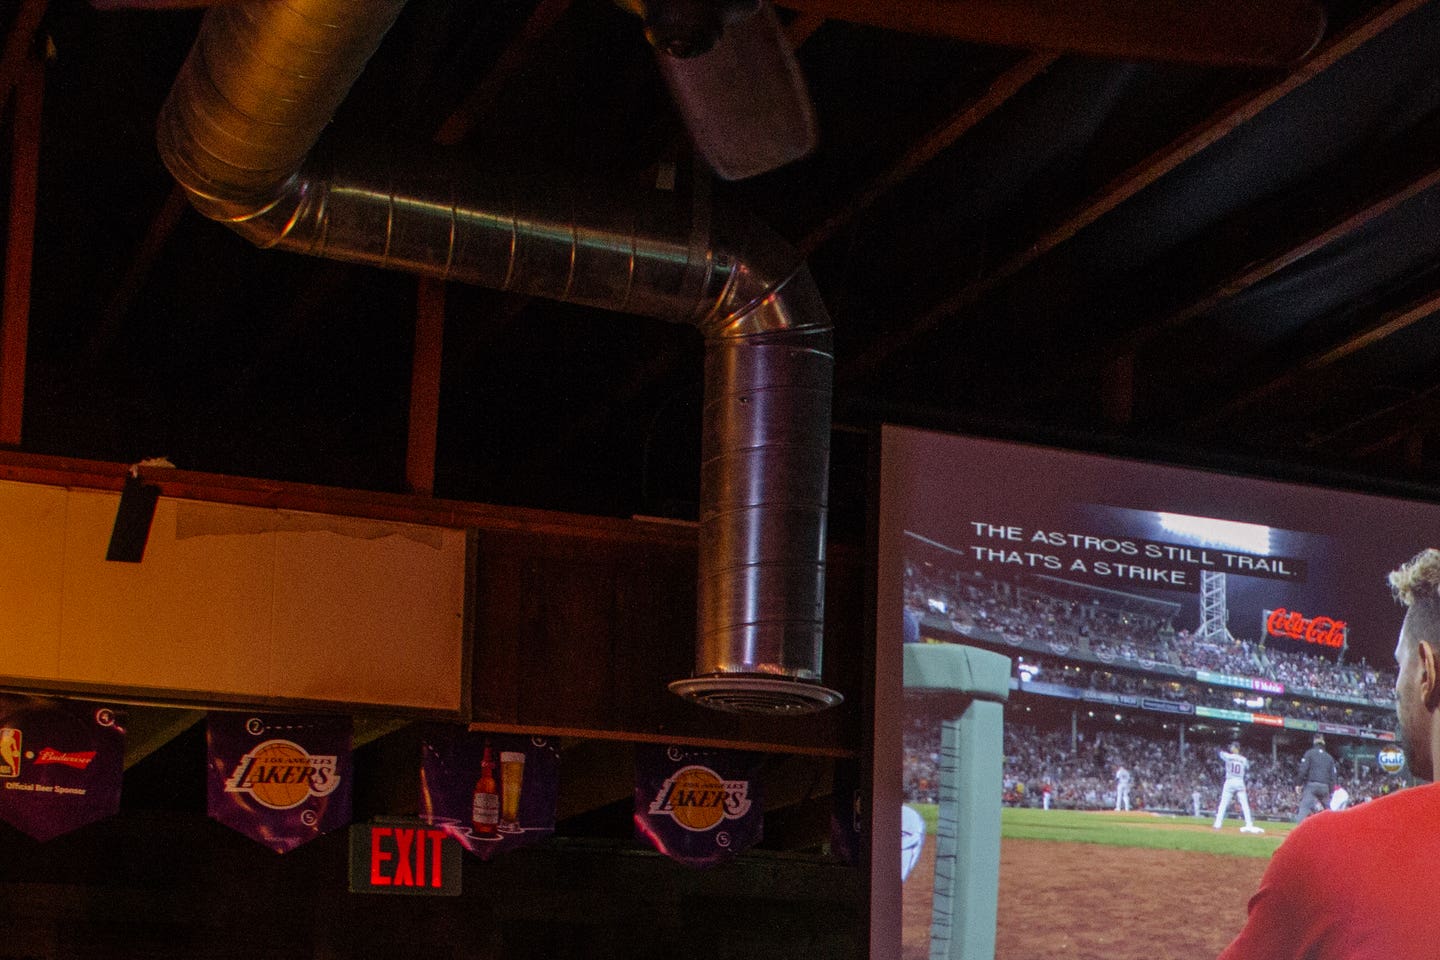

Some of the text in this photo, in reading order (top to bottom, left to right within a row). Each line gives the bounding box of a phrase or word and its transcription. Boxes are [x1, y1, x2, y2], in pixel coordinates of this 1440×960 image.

[971, 522, 1298, 576] THE ASTROS STILL TRAIL.
[971, 546, 1193, 586] THAT'S A STRIKE.
[40, 750, 93, 764] Budweiser
[1231, 762, 1241, 774] 10
[1379, 753, 1403, 764] Gulf
[4, 782, 87, 796] Official Beer Sponsor
[235, 757, 331, 793] LAKERS
[659, 781, 743, 816] LAKERS
[370, 827, 447, 888] EXIT
